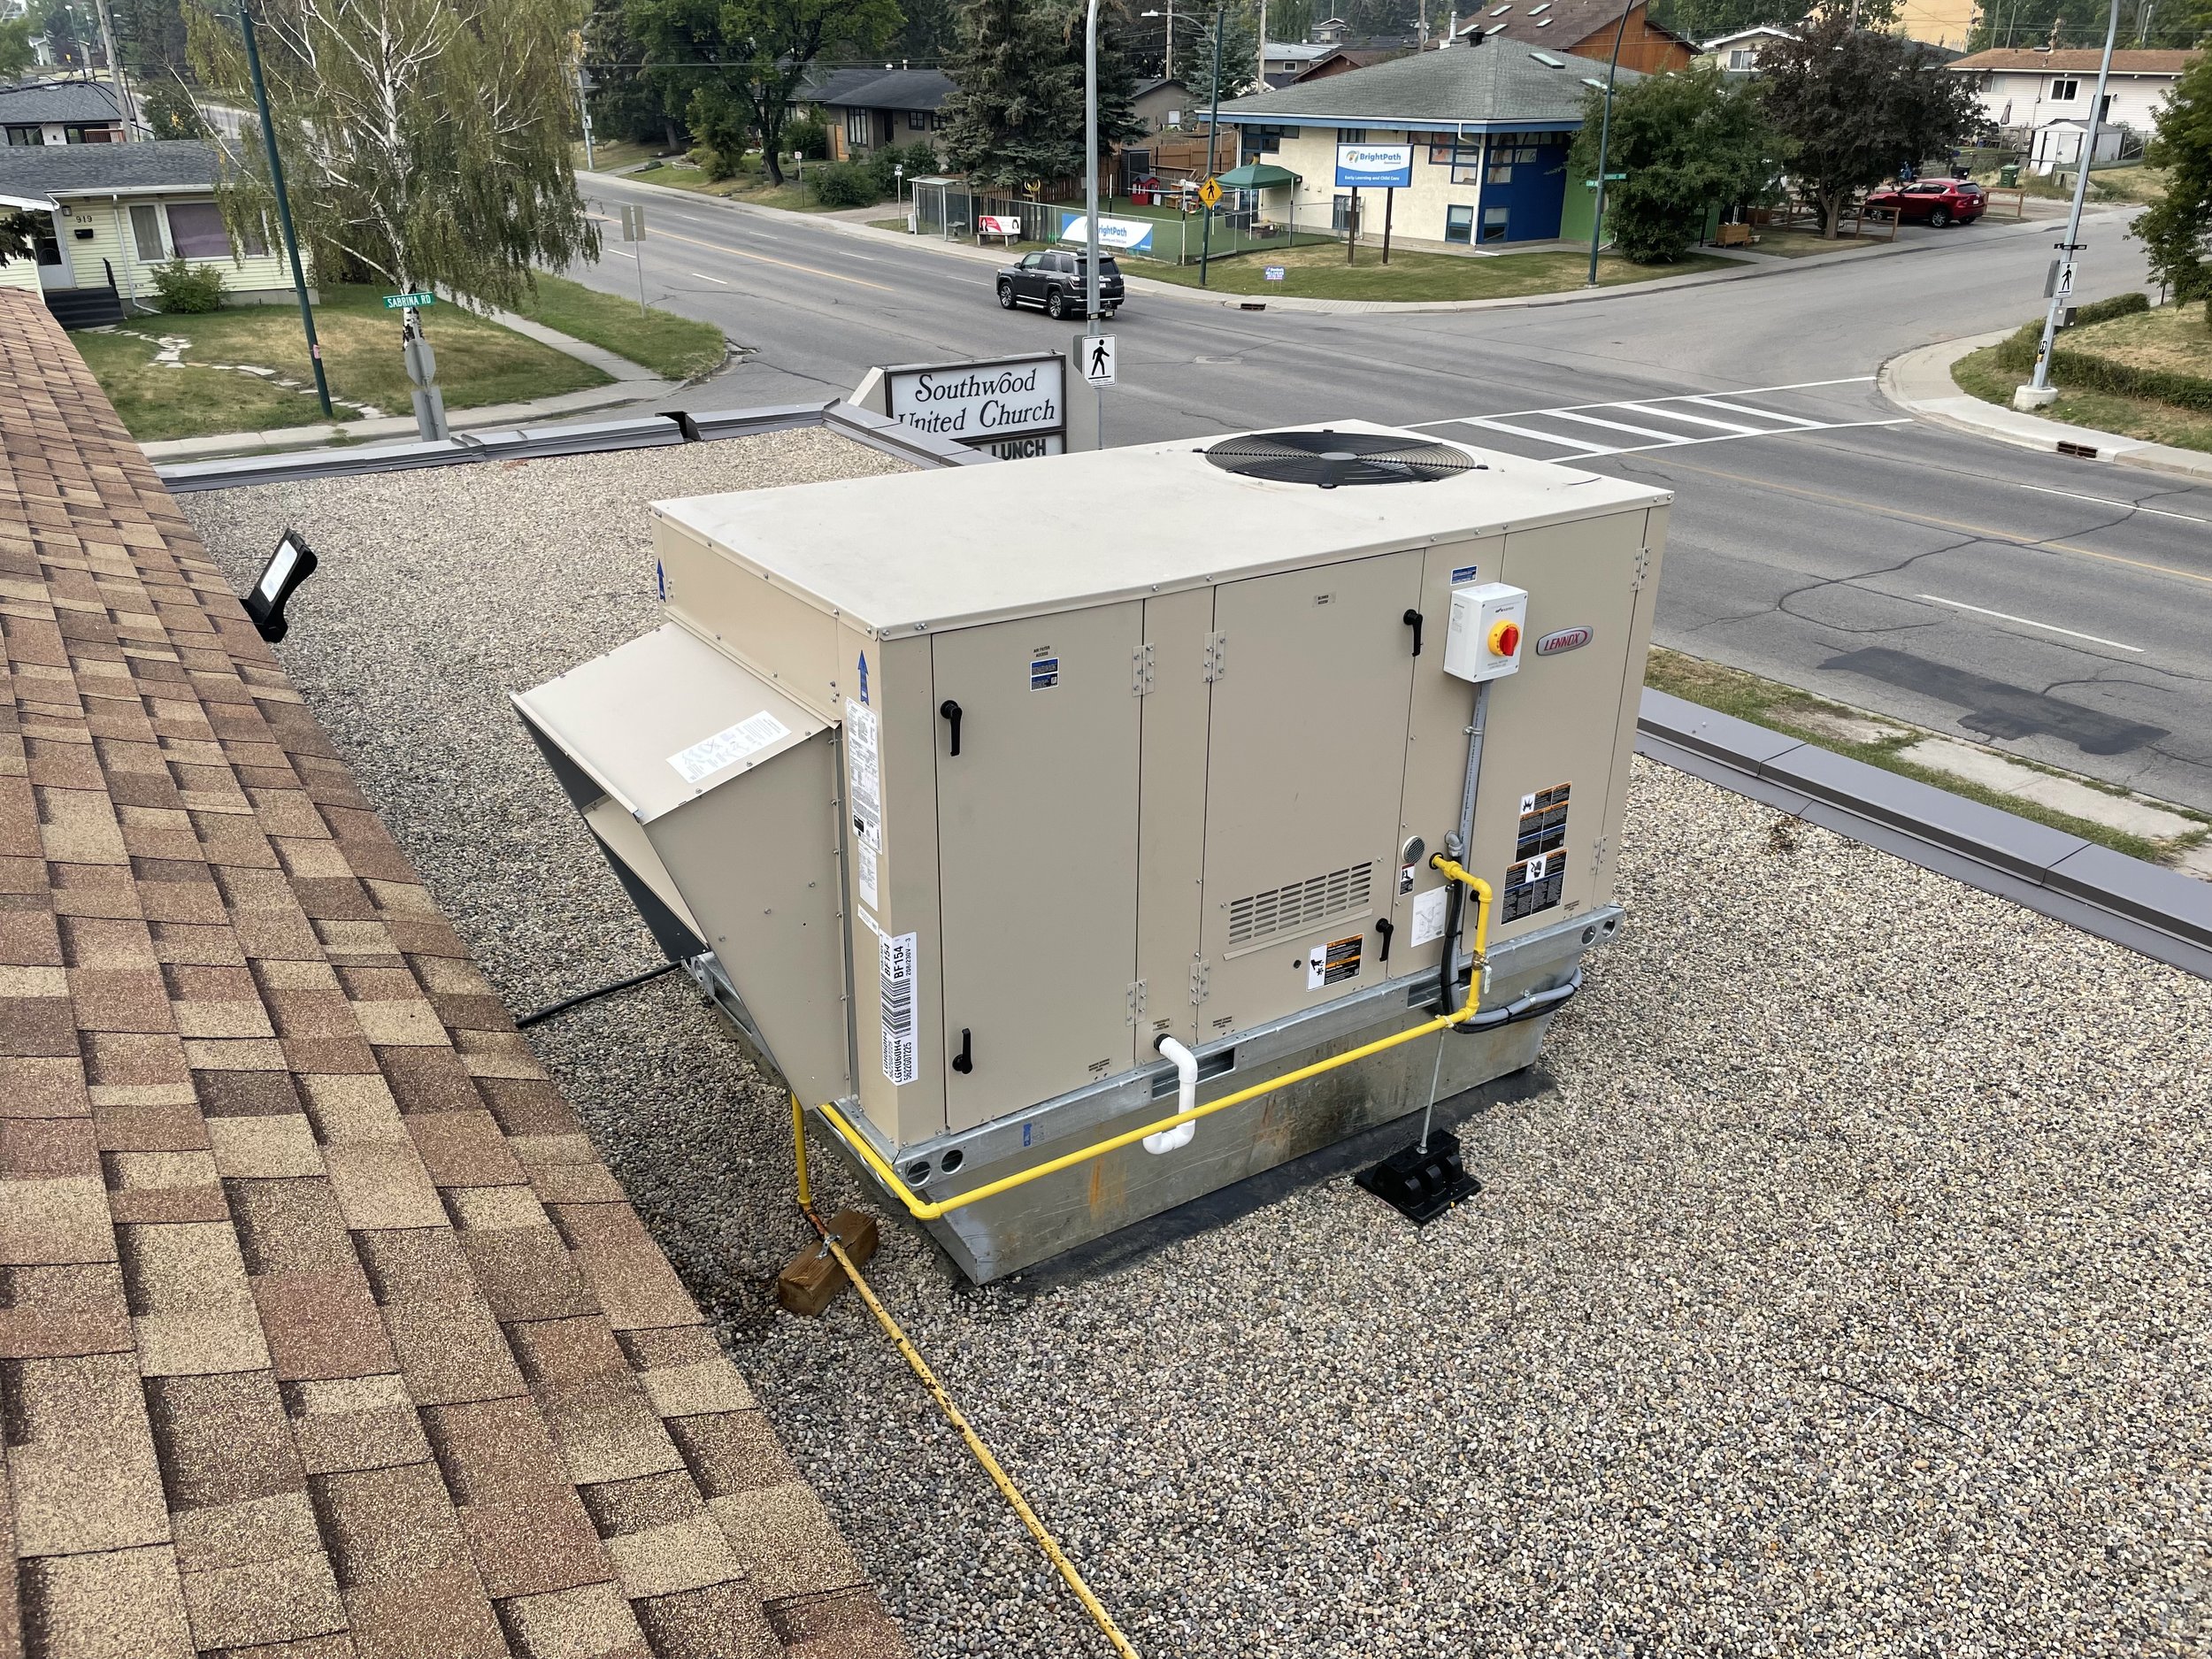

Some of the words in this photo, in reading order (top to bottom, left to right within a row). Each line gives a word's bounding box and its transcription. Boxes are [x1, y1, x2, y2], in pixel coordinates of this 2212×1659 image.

[1098, 225, 1127, 237] rightPath
[387, 296, 420, 308] SABRINA
[420, 294, 432, 304] RD
[915, 368, 1037, 402] Southwood
[979, 398, 1056, 428] Church
[991, 438, 1047, 461] LUNCH
[1544, 633, 1581, 651] LENNOX
[893, 945, 904, 979] BF154
[894, 1040, 902, 1083] LGH060H4
